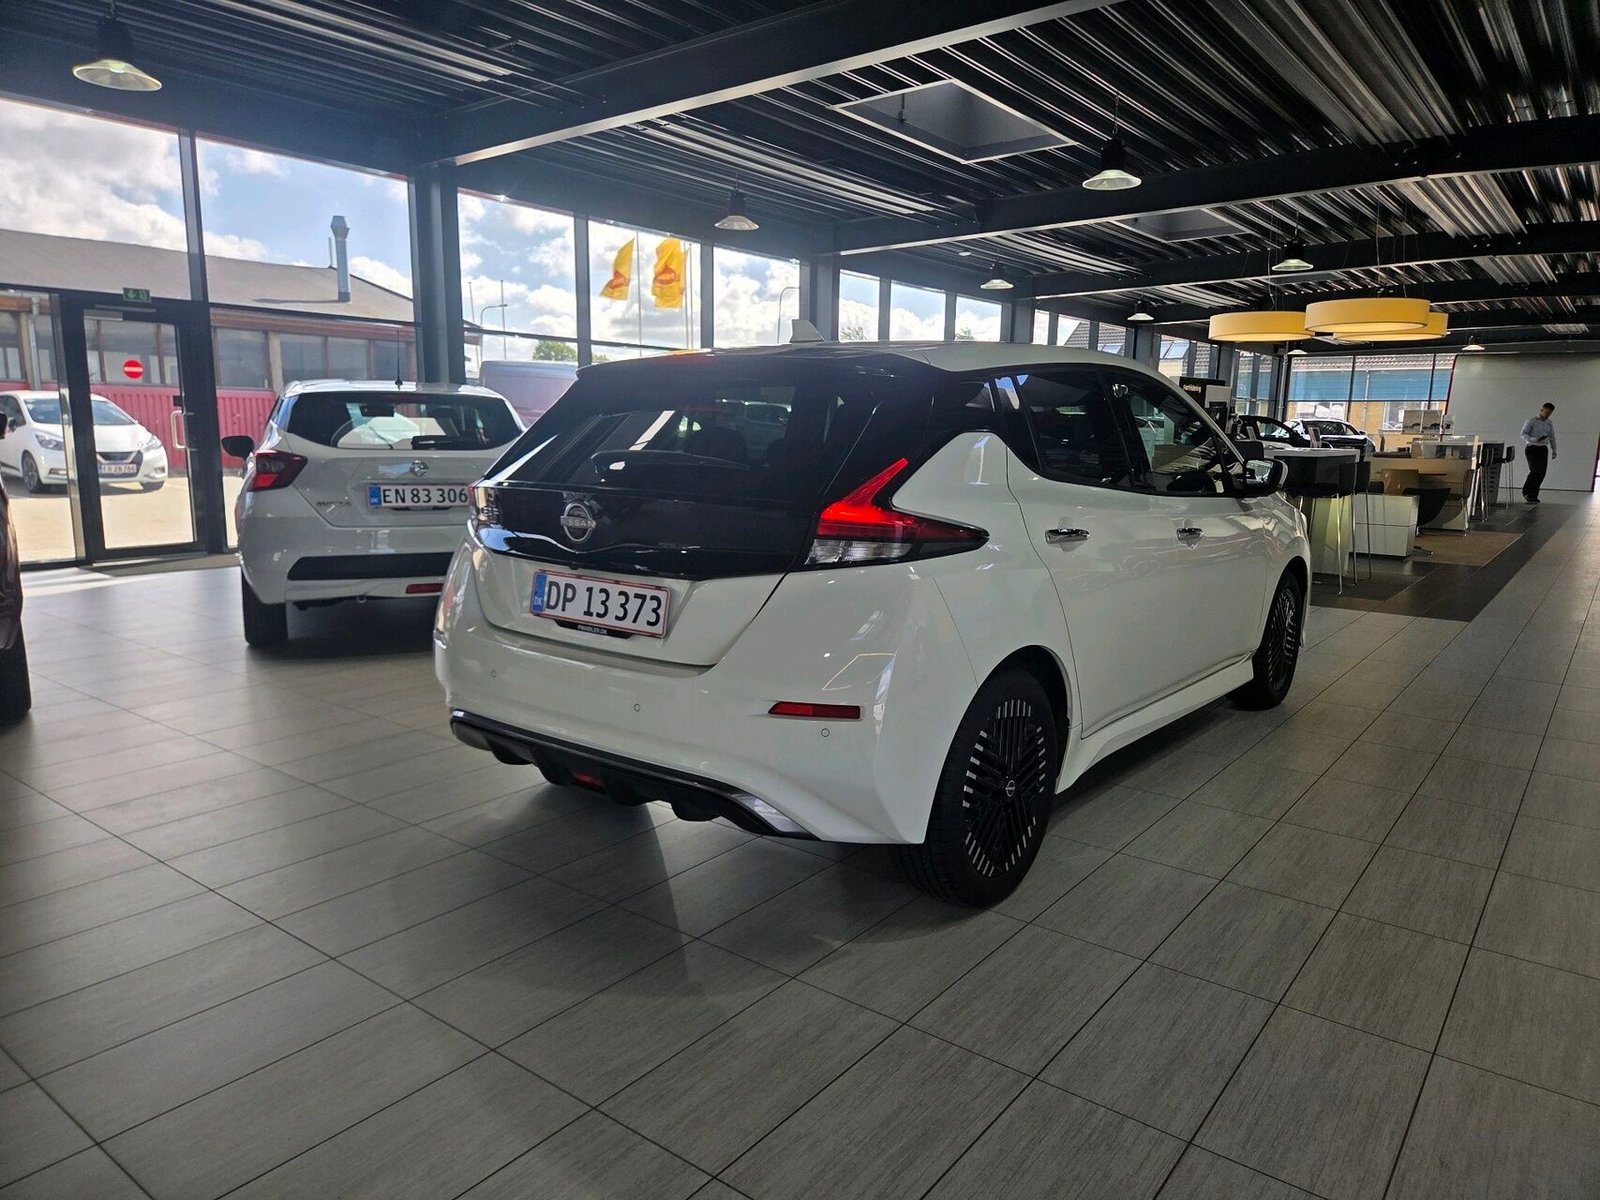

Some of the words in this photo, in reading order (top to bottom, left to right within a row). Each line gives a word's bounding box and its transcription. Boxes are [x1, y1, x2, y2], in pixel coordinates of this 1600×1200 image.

[383, 488, 406, 504] EN
[411, 487, 431, 504] 83
[437, 488, 468, 504] 306
[533, 596, 543, 606] DK
[546, 580, 577, 612] DP
[583, 586, 610, 619] 13
[614, 590, 662, 627] 373
